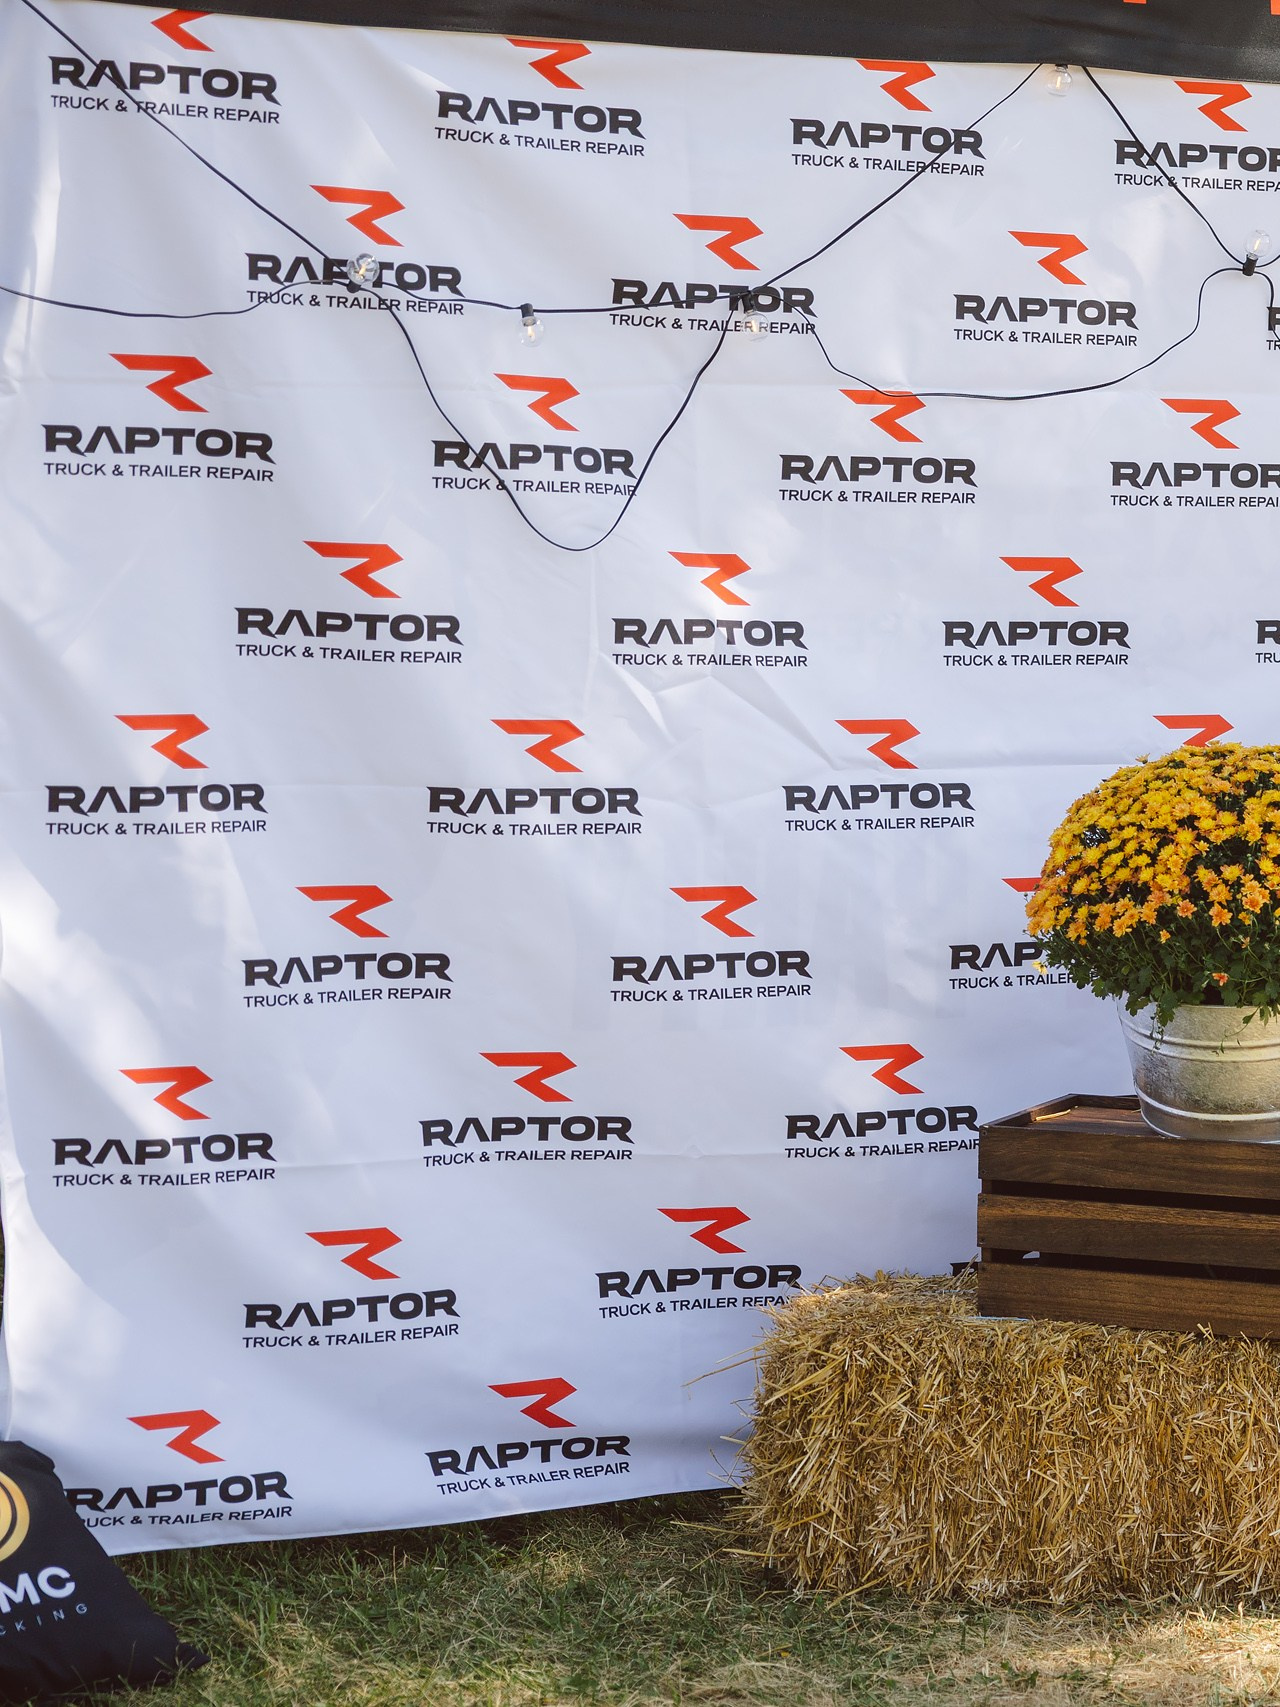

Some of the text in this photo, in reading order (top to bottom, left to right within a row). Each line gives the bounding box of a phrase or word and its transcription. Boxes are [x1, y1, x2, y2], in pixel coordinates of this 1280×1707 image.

[48, 56, 282, 106] RAPTOR
[50, 94, 280, 124] TRUCK & TRAILER REPAIR
[437, 91, 645, 139] RAPTOR
[434, 126, 645, 157] TRUCK & TRAILER REPAIR
[790, 118, 986, 160] RAPTOR
[791, 153, 986, 177] TRUCK & TRAILER REPAIR
[611, 279, 818, 318] RAPTOR
[954, 294, 1139, 330] RAPTOR
[953, 328, 1138, 347] TRUCK & TRAILER REPAIR
[42, 425, 275, 464] RAPTOR
[431, 440, 638, 479] RAPTOR
[43, 462, 274, 482] TRUCK & TRAILER REPAIR
[780, 455, 977, 487] RAPTOR
[778, 489, 976, 504] TRUCK & TRAILER REPAIR
[1110, 494, 1160, 507] TRUCK
[1162, 495, 1173, 507] &
[1176, 495, 1235, 508] TRAILER
[235, 608, 463, 645] RAPTOR
[612, 618, 808, 650] RAPTOR
[942, 621, 1131, 649] RAPTOR
[235, 644, 462, 664] TRUCK & TRAILER REPAIR
[611, 653, 808, 667] TRUCK & TRAILER REPAIR
[942, 653, 1129, 667] TRUCK & TRAILER REPAIR
[45, 784, 267, 816] RAPTOR
[427, 787, 642, 817] RAPTOR
[782, 783, 975, 814] RAPTOR
[45, 819, 267, 836] TRUCK & TRAILER REPAIR
[426, 821, 642, 836] TRUCK & TRAILER REPAIR
[784, 816, 975, 832] TRUCK & TRAILER REPAIR
[242, 953, 453, 988] RAPTOR
[611, 951, 812, 985] RAPTOR
[949, 942, 1043, 972] RAP
[243, 987, 452, 1008] TRUCK & TRAILER REPAIR
[610, 984, 812, 1002] TRUCK & TRAILER REPAIR
[949, 975, 999, 990] TRUCK
[1003, 976, 1014, 987] &
[419, 1116, 634, 1147] RAPTOR
[784, 1105, 980, 1142] RAPTOR
[52, 1133, 276, 1167] RAPTOR
[423, 1149, 633, 1168] TRUCK & TRAILER REPAIR
[784, 1146, 840, 1159] TRUCK
[844, 1146, 856, 1158] &
[859, 1142, 925, 1157] TRAILER
[52, 1168, 276, 1187] TRUCK & TRAILER REPAIR
[596, 1265, 804, 1299] RAPTOR
[243, 1289, 460, 1331] RAPTOR
[242, 1323, 459, 1349] TRUCK & TRAILER REPAIR
[425, 1436, 631, 1476] RAPTOR
[64, 1471, 294, 1512] RAPTOR
[436, 1461, 631, 1495] TRUCK & TRAILER REPAIR
[0, 1566, 76, 1614] MC
